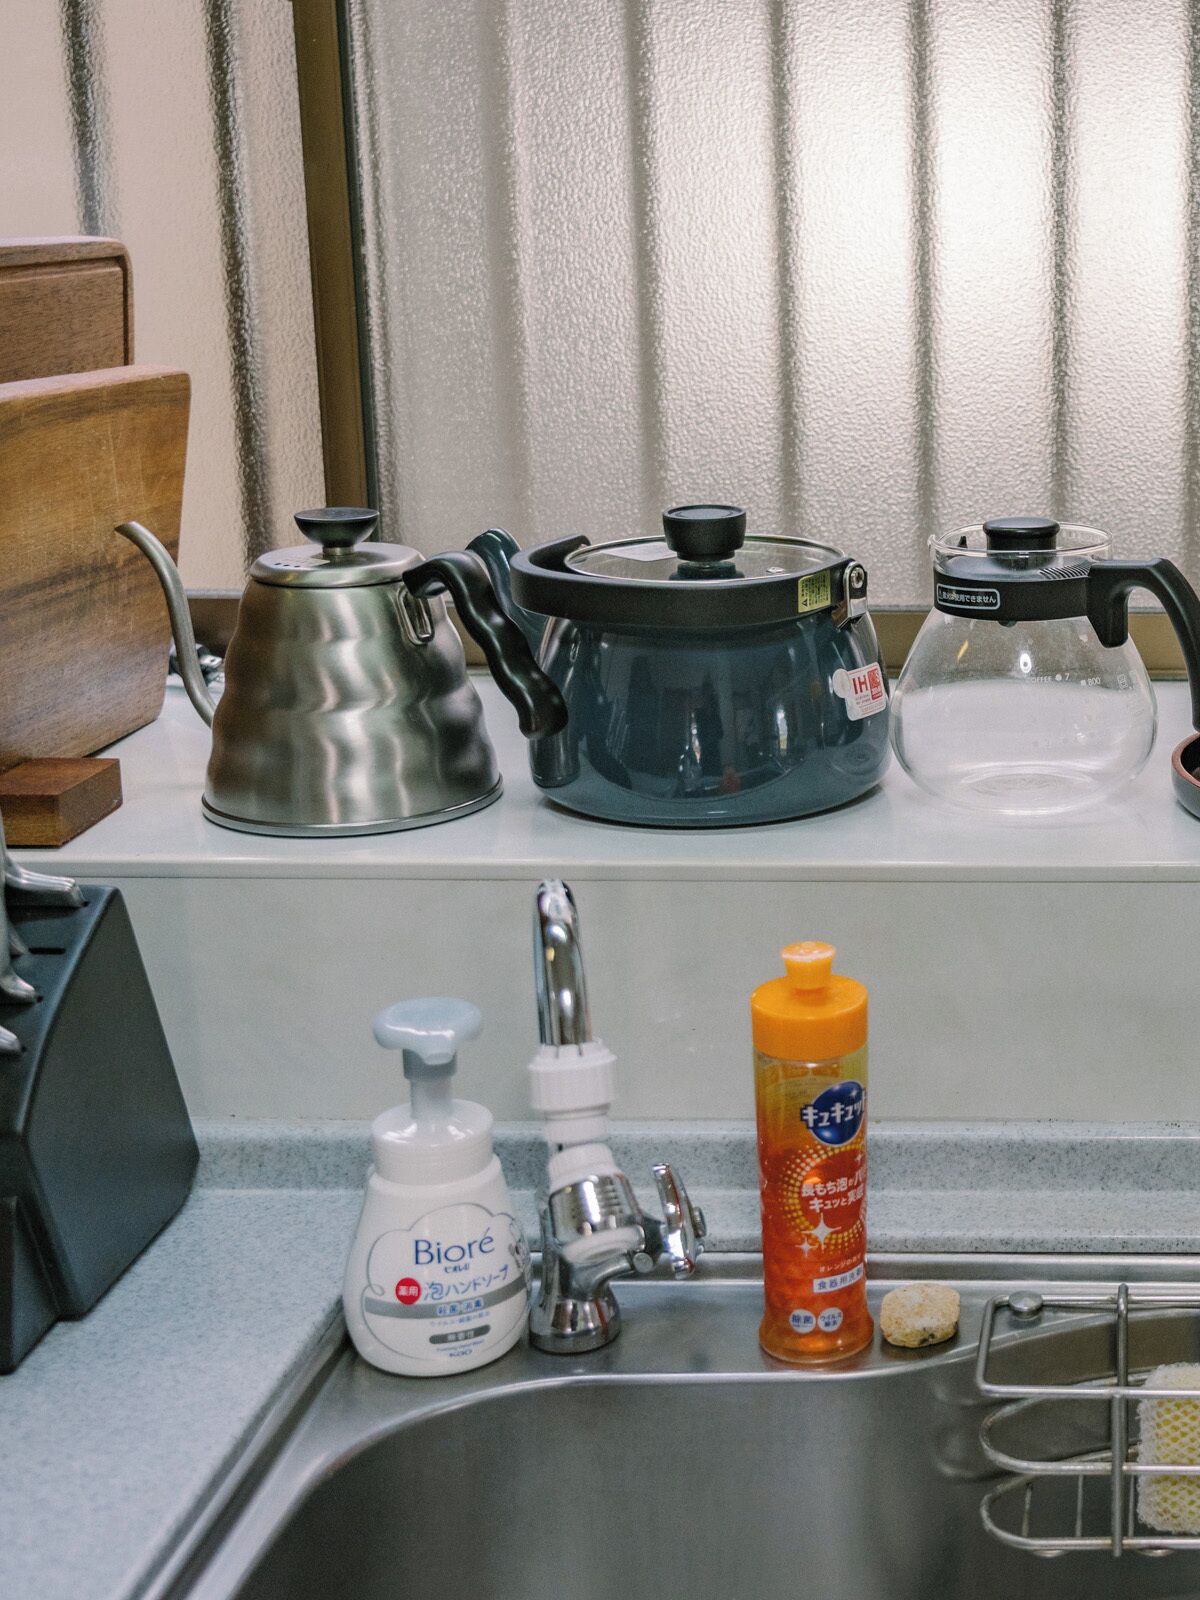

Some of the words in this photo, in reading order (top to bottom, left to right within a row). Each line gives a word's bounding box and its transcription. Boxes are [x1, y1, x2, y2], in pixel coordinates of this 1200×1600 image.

[852, 674, 868, 695] IH
[415, 1227, 495, 1265] Bioré
[423, 1264, 509, 1301] 泡ハンドソープ
